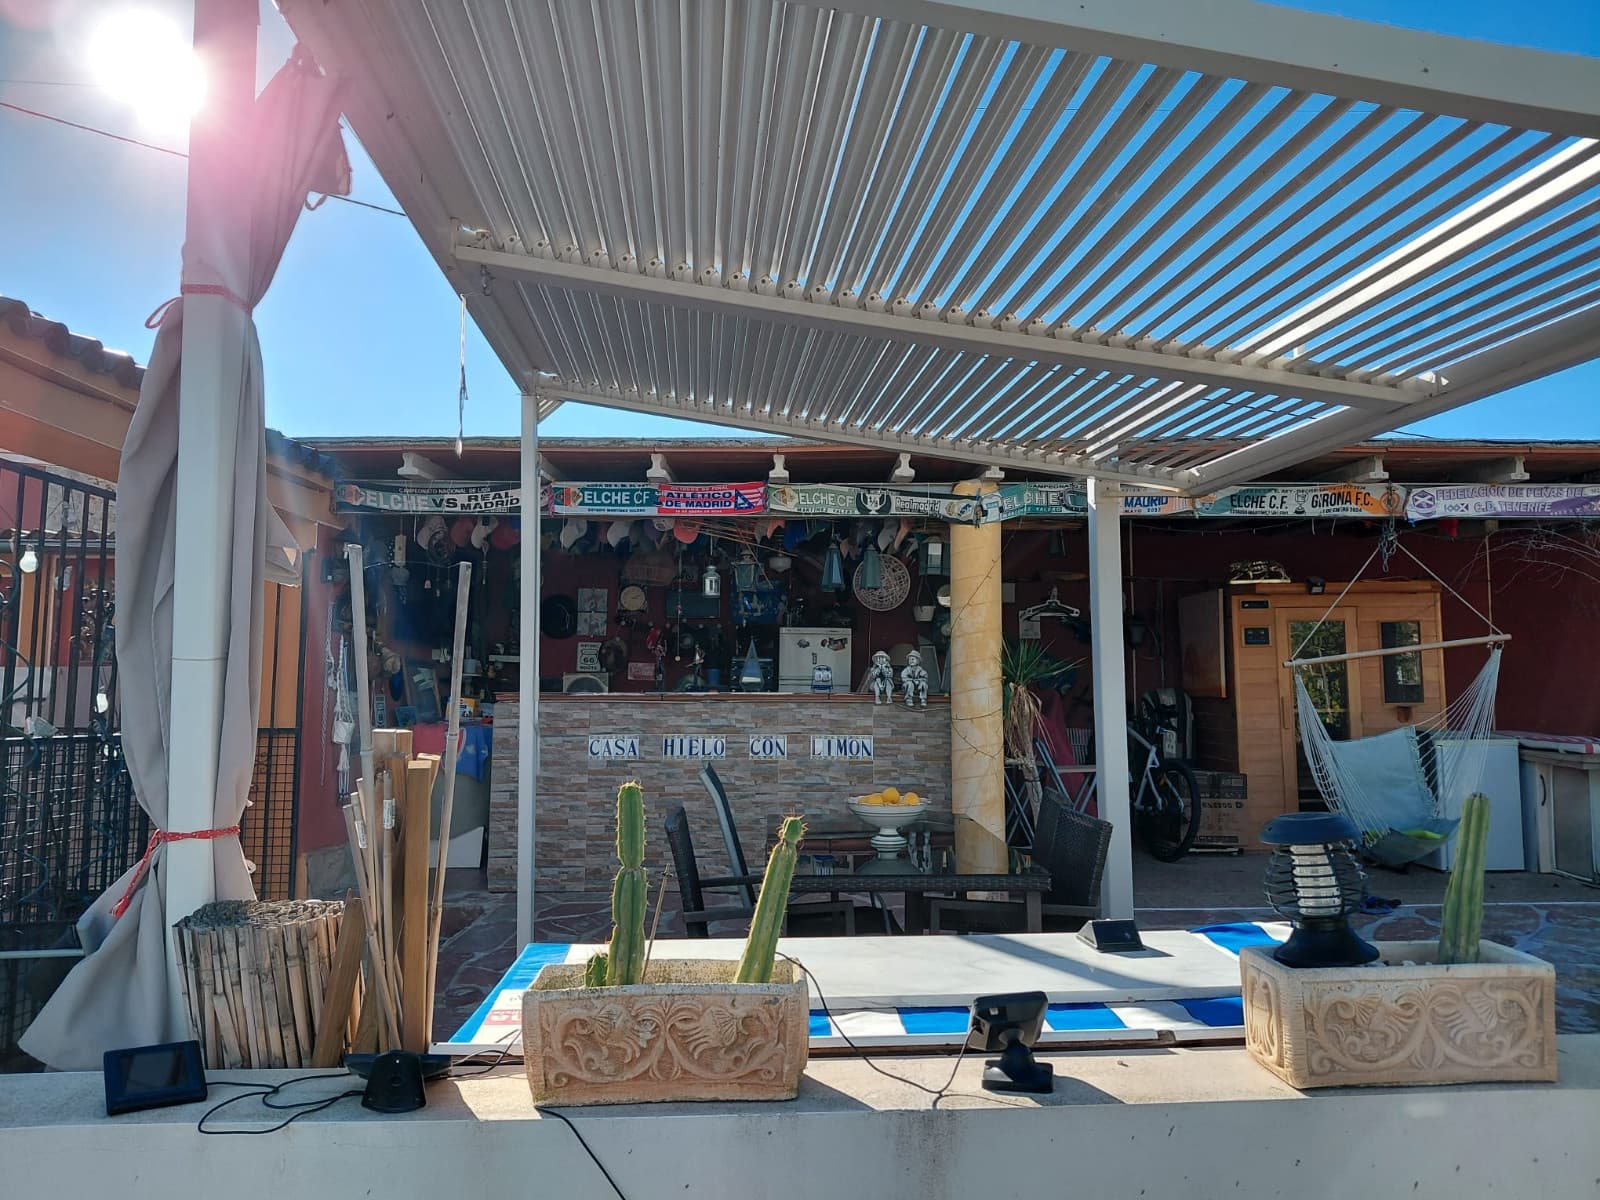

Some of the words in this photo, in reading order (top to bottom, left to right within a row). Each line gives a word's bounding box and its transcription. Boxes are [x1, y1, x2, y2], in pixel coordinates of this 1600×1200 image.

[468, 491, 514, 502] REAL
[584, 491, 631, 505] ELCHE
[633, 490, 650, 504] CF
[1508, 487, 1525, 498] DE
[366, 490, 430, 511] ELCHE
[432, 497, 458, 509] VS
[460, 498, 520, 511] MADRID
[685, 500, 732, 508] MADRID
[799, 492, 836, 506] ELCHE
[837, 494, 854, 507] CF
[1124, 496, 1169, 508] MADRID
[1230, 494, 1265, 509] ELCHE
[1268, 494, 1288, 509] C.F.
[1311, 491, 1351, 508] GIRONA
[1355, 491, 1373, 506] F.C.
[1498, 501, 1552, 513] TENERIFE
[589, 738, 638, 756] CASA
[663, 738, 725, 755] HIELO
[750, 738, 786, 756] CON
[811, 738, 872, 756] LIMON
